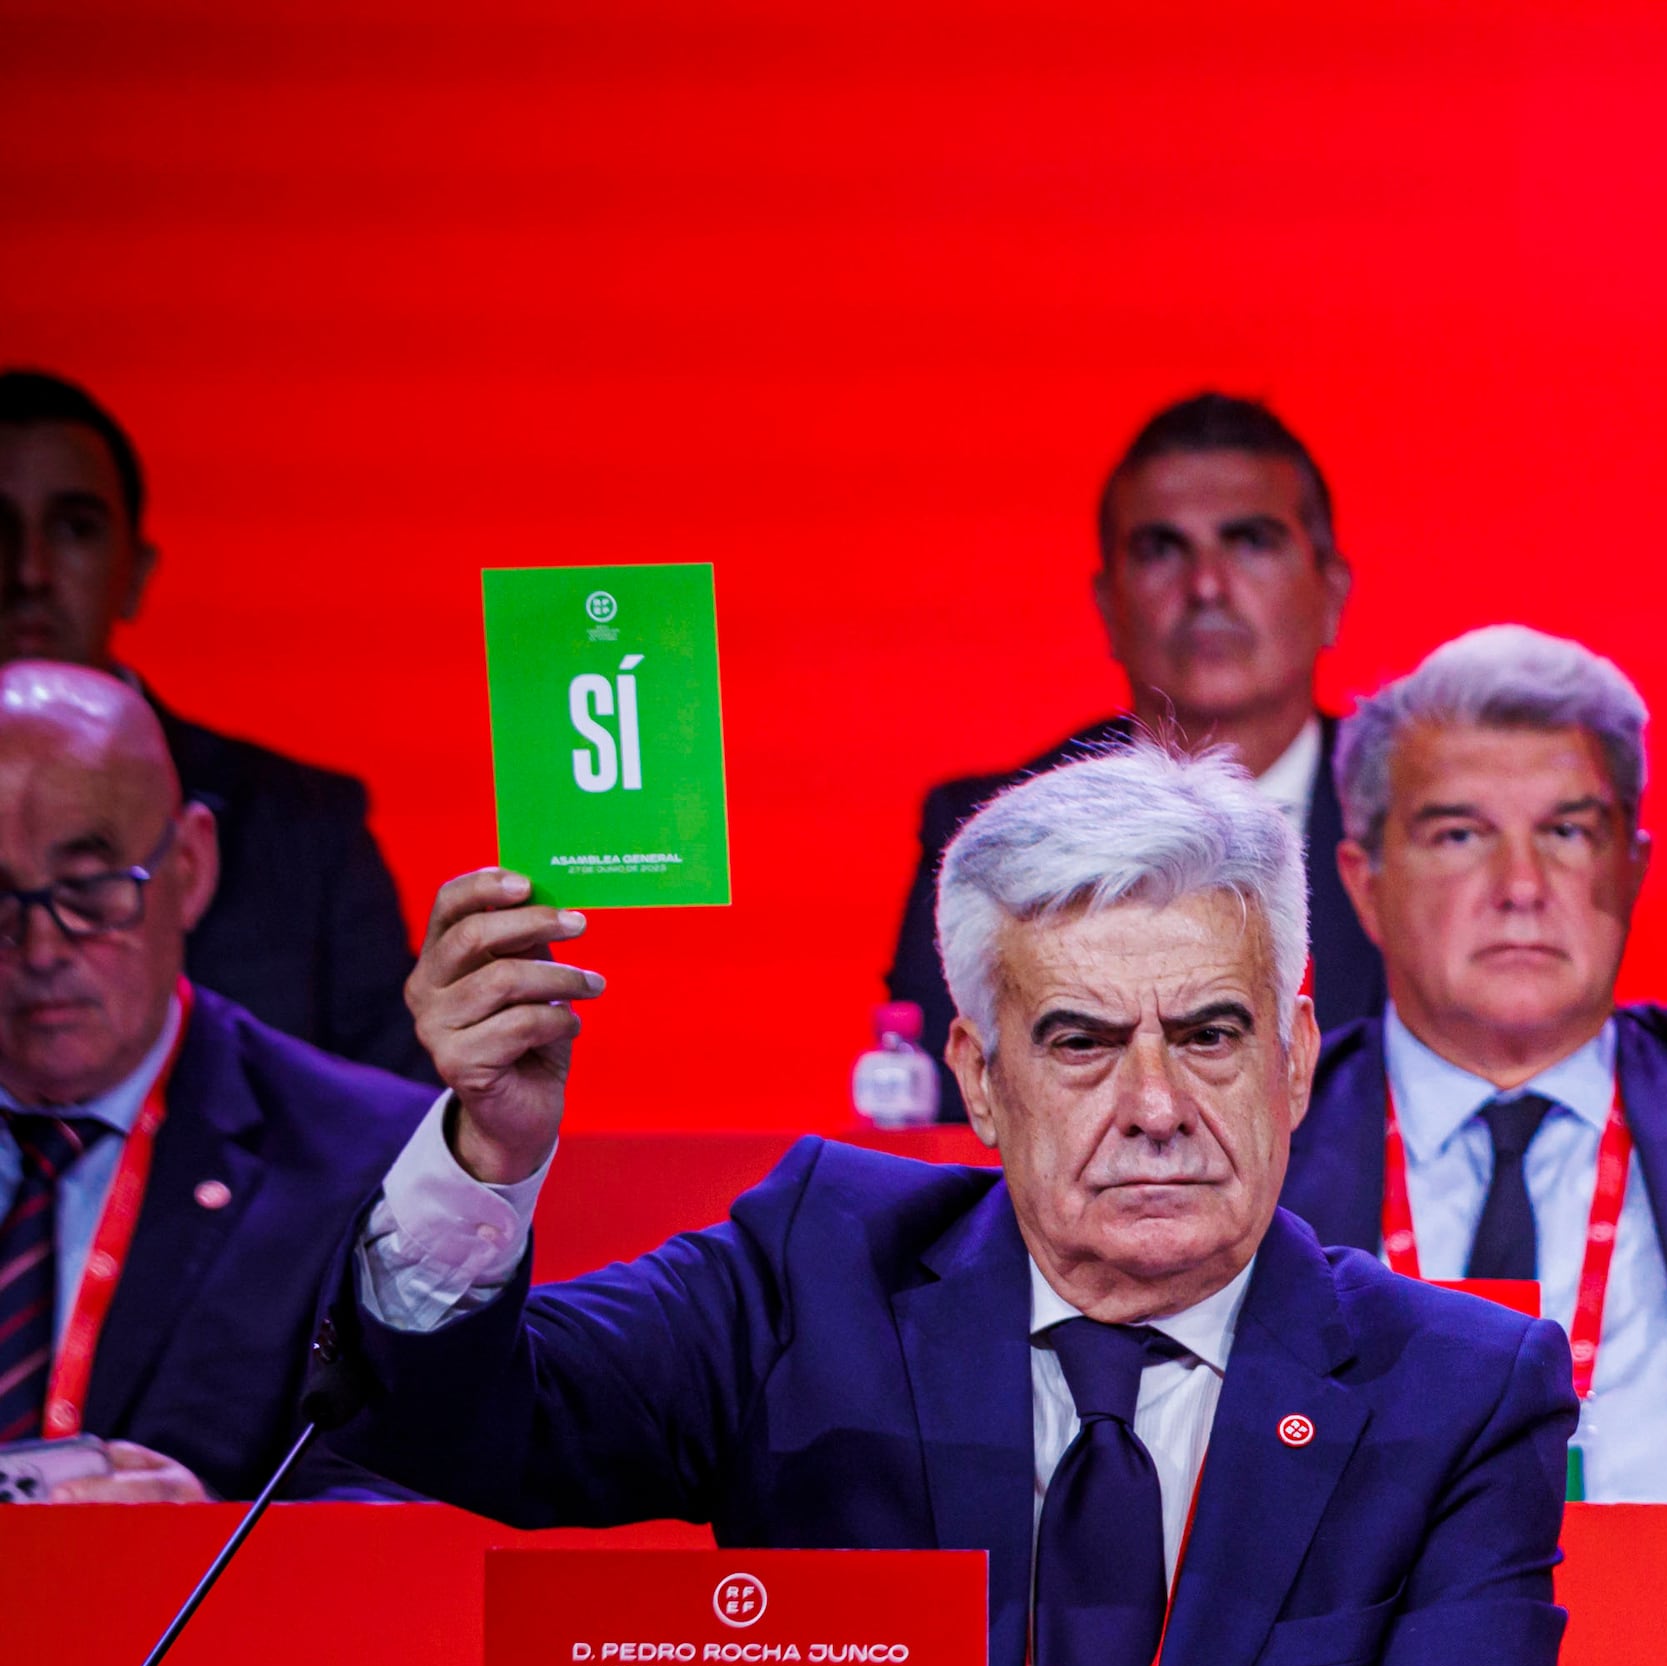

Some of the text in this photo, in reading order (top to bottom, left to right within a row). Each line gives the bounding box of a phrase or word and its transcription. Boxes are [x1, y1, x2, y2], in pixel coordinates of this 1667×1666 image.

[568, 654, 645, 793] SÍ
[572, 1642, 910, 1663] D. PEDRO ROCHA JUNCO
